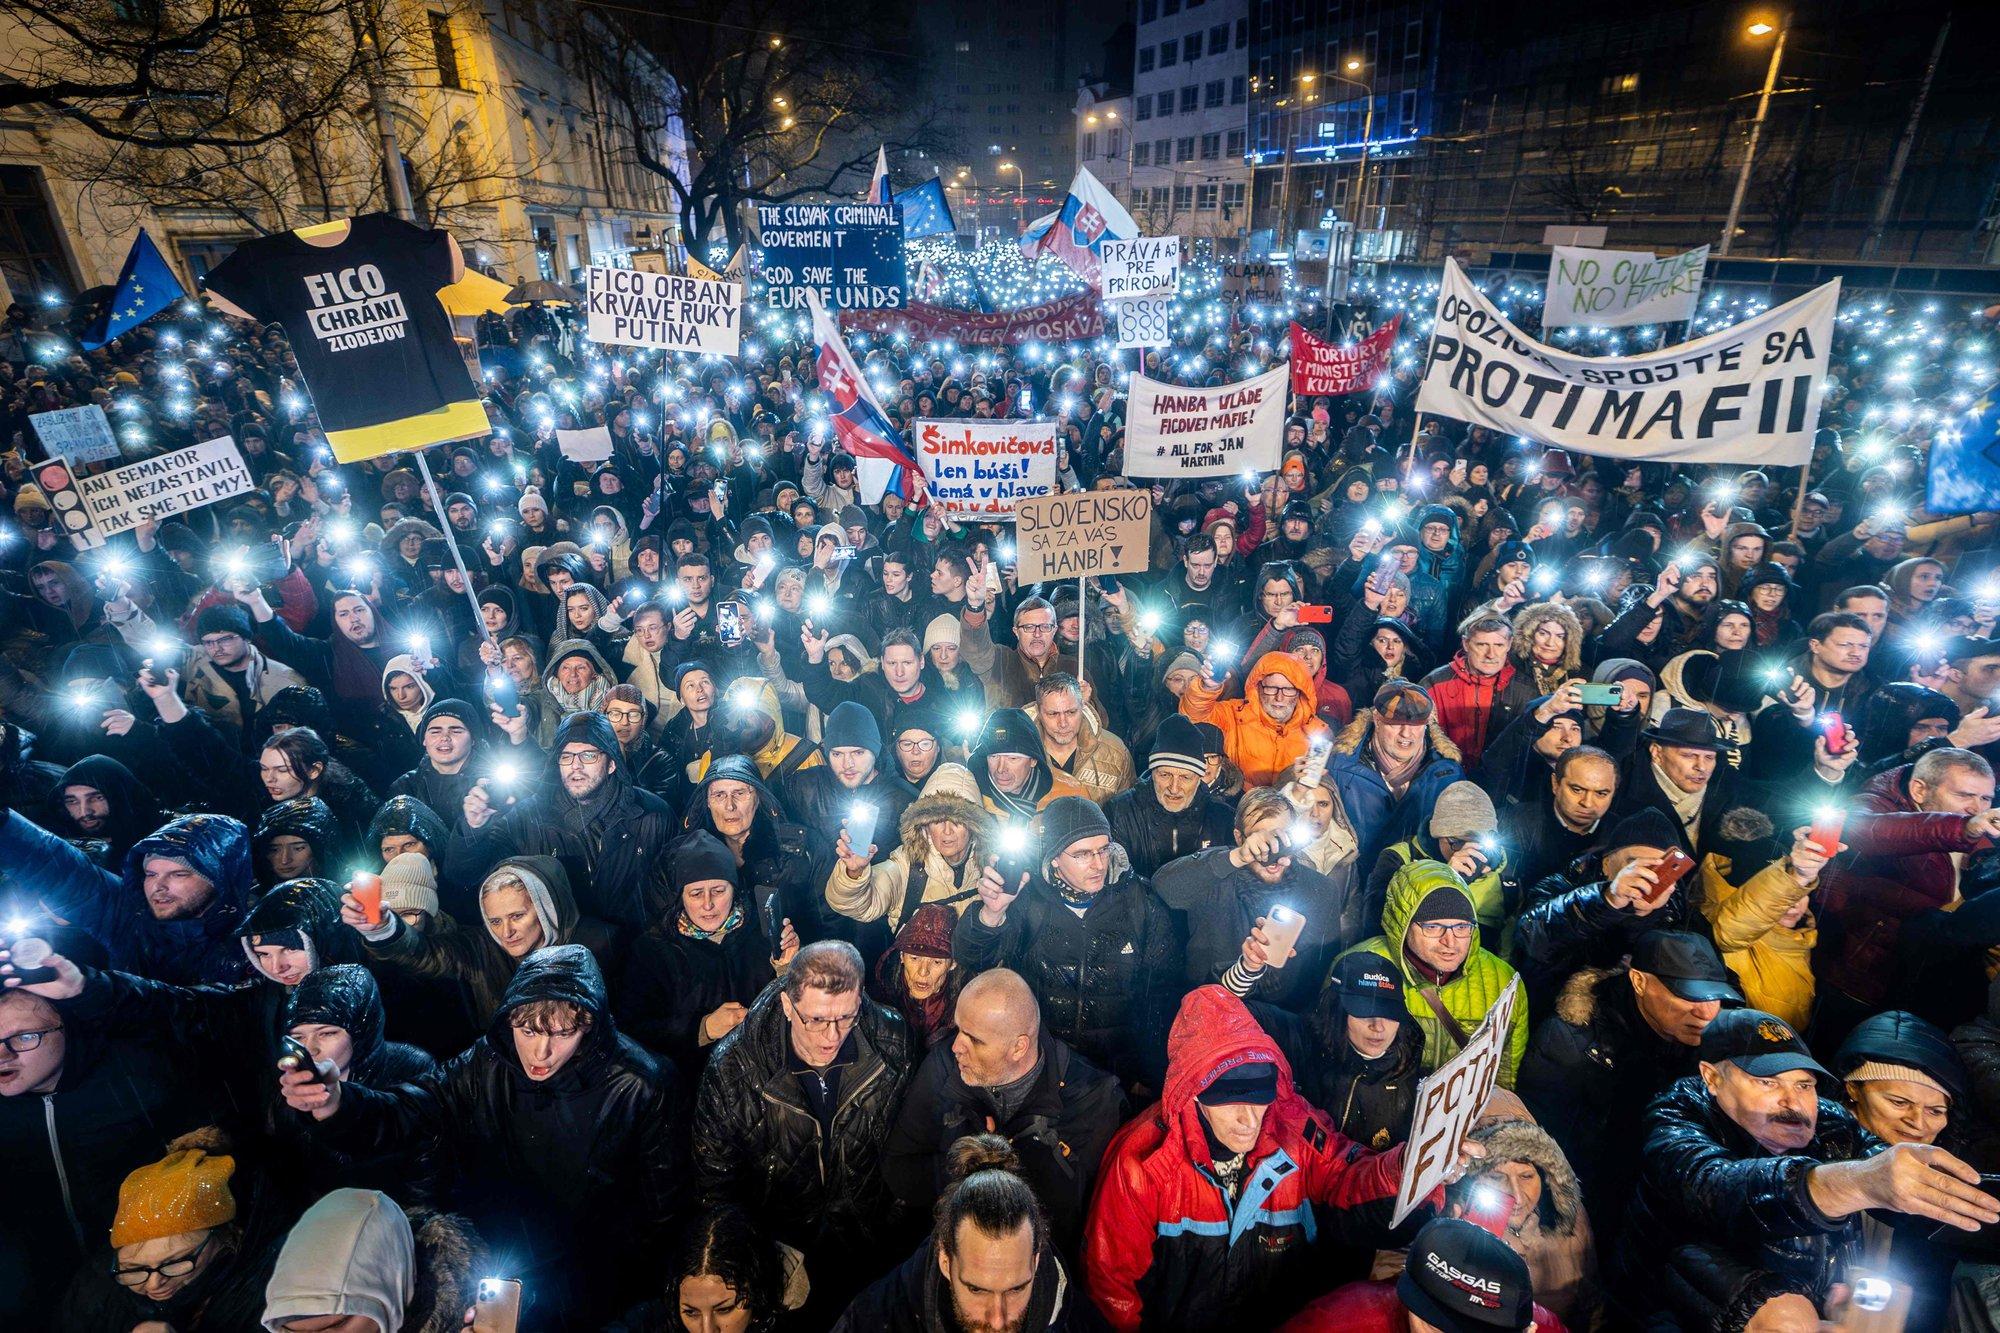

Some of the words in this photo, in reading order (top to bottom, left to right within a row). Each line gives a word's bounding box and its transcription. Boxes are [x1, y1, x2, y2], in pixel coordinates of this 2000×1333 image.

[759, 206, 781, 226] THE
[785, 206, 831, 227] SLOVAK
[834, 205, 899, 226] CRIMINAL
[761, 230, 847, 248] GOVERMENT
[1103, 240, 1161, 263] PRÁVA
[765, 266, 794, 285] GOD
[802, 266, 833, 285] SAVE
[844, 267, 868, 285] THE
[1126, 260, 1155, 274] PRE
[1557, 259, 1600, 286] NO
[1613, 252, 1702, 285] CULTURE
[303, 263, 386, 308] FICO
[590, 268, 644, 296] FICO
[654, 276, 731, 306] ORBAN
[1573, 286, 1616, 313] NO
[316, 299, 401, 332] CHRÁNI
[589, 291, 675, 322] KRVAVE
[680, 302, 737, 328] RUKY
[327, 323, 406, 353] ZLODEJOV
[615, 317, 702, 346] PUTINA
[1014, 316, 1106, 341] MOSKVA
[1311, 341, 1378, 363] TORTURY
[1582, 341, 1744, 385] SPOJTE
[1762, 327, 1816, 366] SA
[1152, 395, 1208, 415] HANBA
[1219, 387, 1264, 411] VLÁDE
[1425, 335, 1586, 430] PROTI
[1587, 375, 1812, 440] MAFII
[1160, 416, 1209, 435] FICOVEJ
[1210, 409, 1256, 430] MAFIE!
[922, 425, 1055, 456] Šimkovičová
[1171, 444, 1190, 457] ALL
[1193, 442, 1214, 455] FOR
[1219, 437, 1245, 451] JAN
[117, 450, 199, 486] SEMAFOR
[935, 459, 967, 480] len
[973, 459, 1030, 480] búši!
[1181, 454, 1225, 468] MARTINA
[99, 510, 136, 533] TAK
[138, 499, 177, 521] SME
[178, 488, 209, 507] TU
[212, 469, 252, 497] MY!
[980, 487, 993, 498] v
[997, 481, 1049, 499] hlave
[969, 502, 981, 512] v
[1020, 496, 1149, 532] SLOVENSKO
[1031, 533, 1051, 551] SA
[1056, 530, 1079, 547] ZA
[1084, 523, 1117, 542] VÁS
[1358, 979, 1378, 987] hlava
[1426, 1252, 1501, 1294] GASGAS
